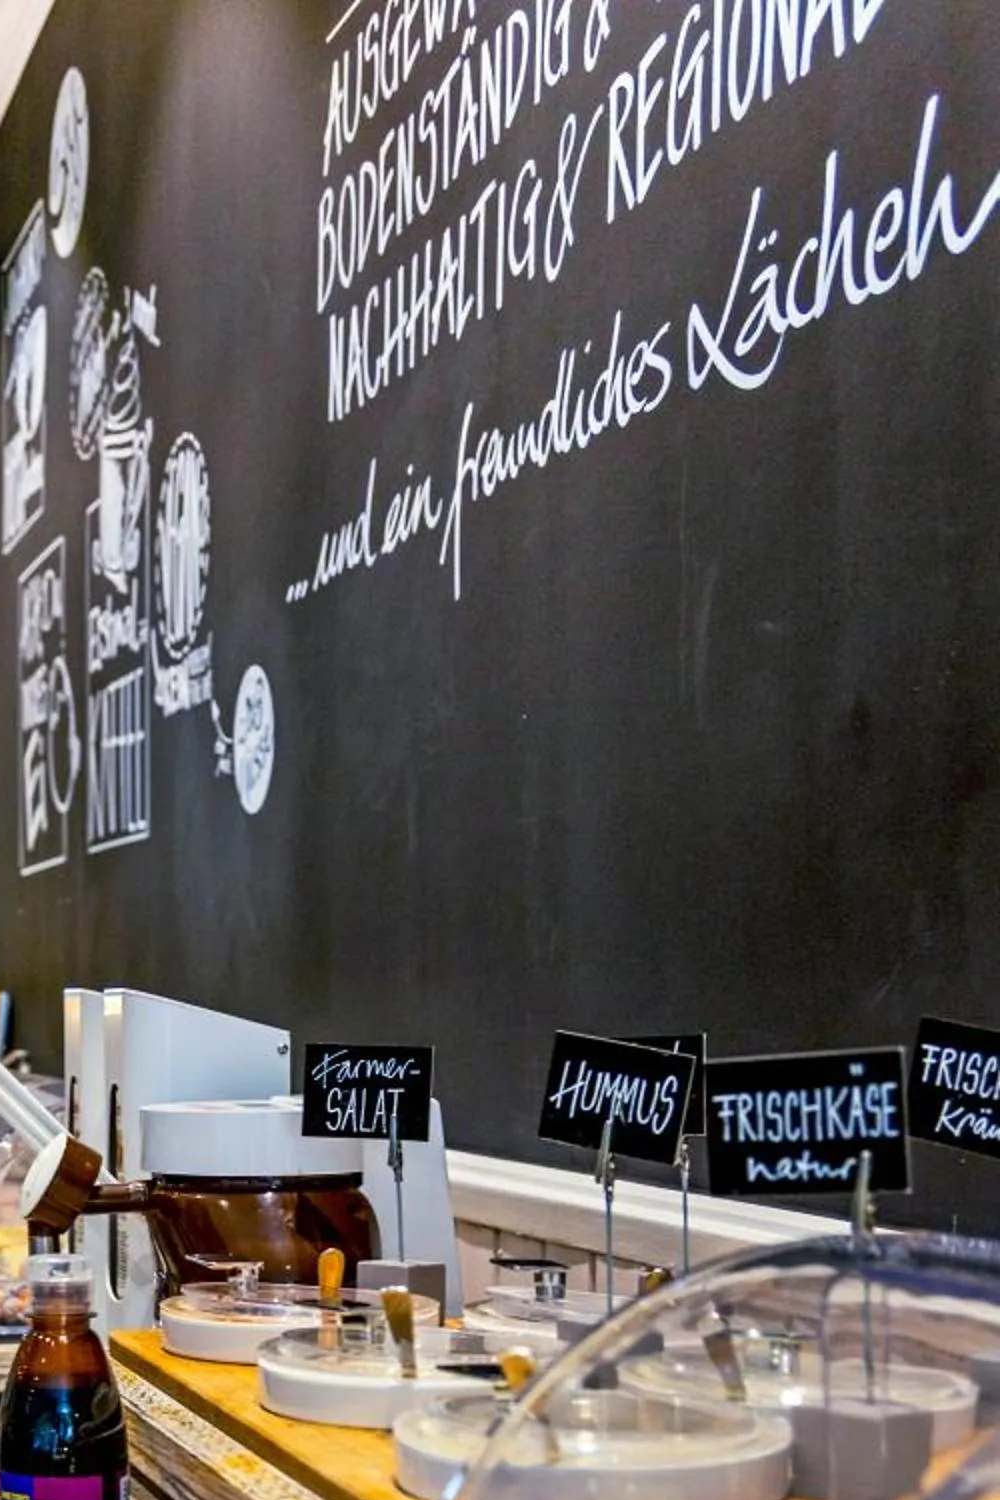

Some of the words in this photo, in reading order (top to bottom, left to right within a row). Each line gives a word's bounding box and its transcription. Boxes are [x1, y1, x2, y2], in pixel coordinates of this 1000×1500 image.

[324, 0, 475, 177] AUSGEW
[317, 0, 570, 315] BODENSTÄNDIG
[327, 160, 543, 423] NACHHALTIG
[607, 0, 884, 224] REGION
[381, 463, 443, 554] ein
[439, 310, 672, 601] freundliches
[311, 1048, 421, 1089] Farmer-
[549, 1059, 678, 1135] HUMMUS
[711, 1062, 899, 1143] FRISCHKÄSE
[921, 1043, 1000, 1101] FRISC
[325, 1087, 405, 1135] SALAT
[746, 1149, 857, 1183] natur
